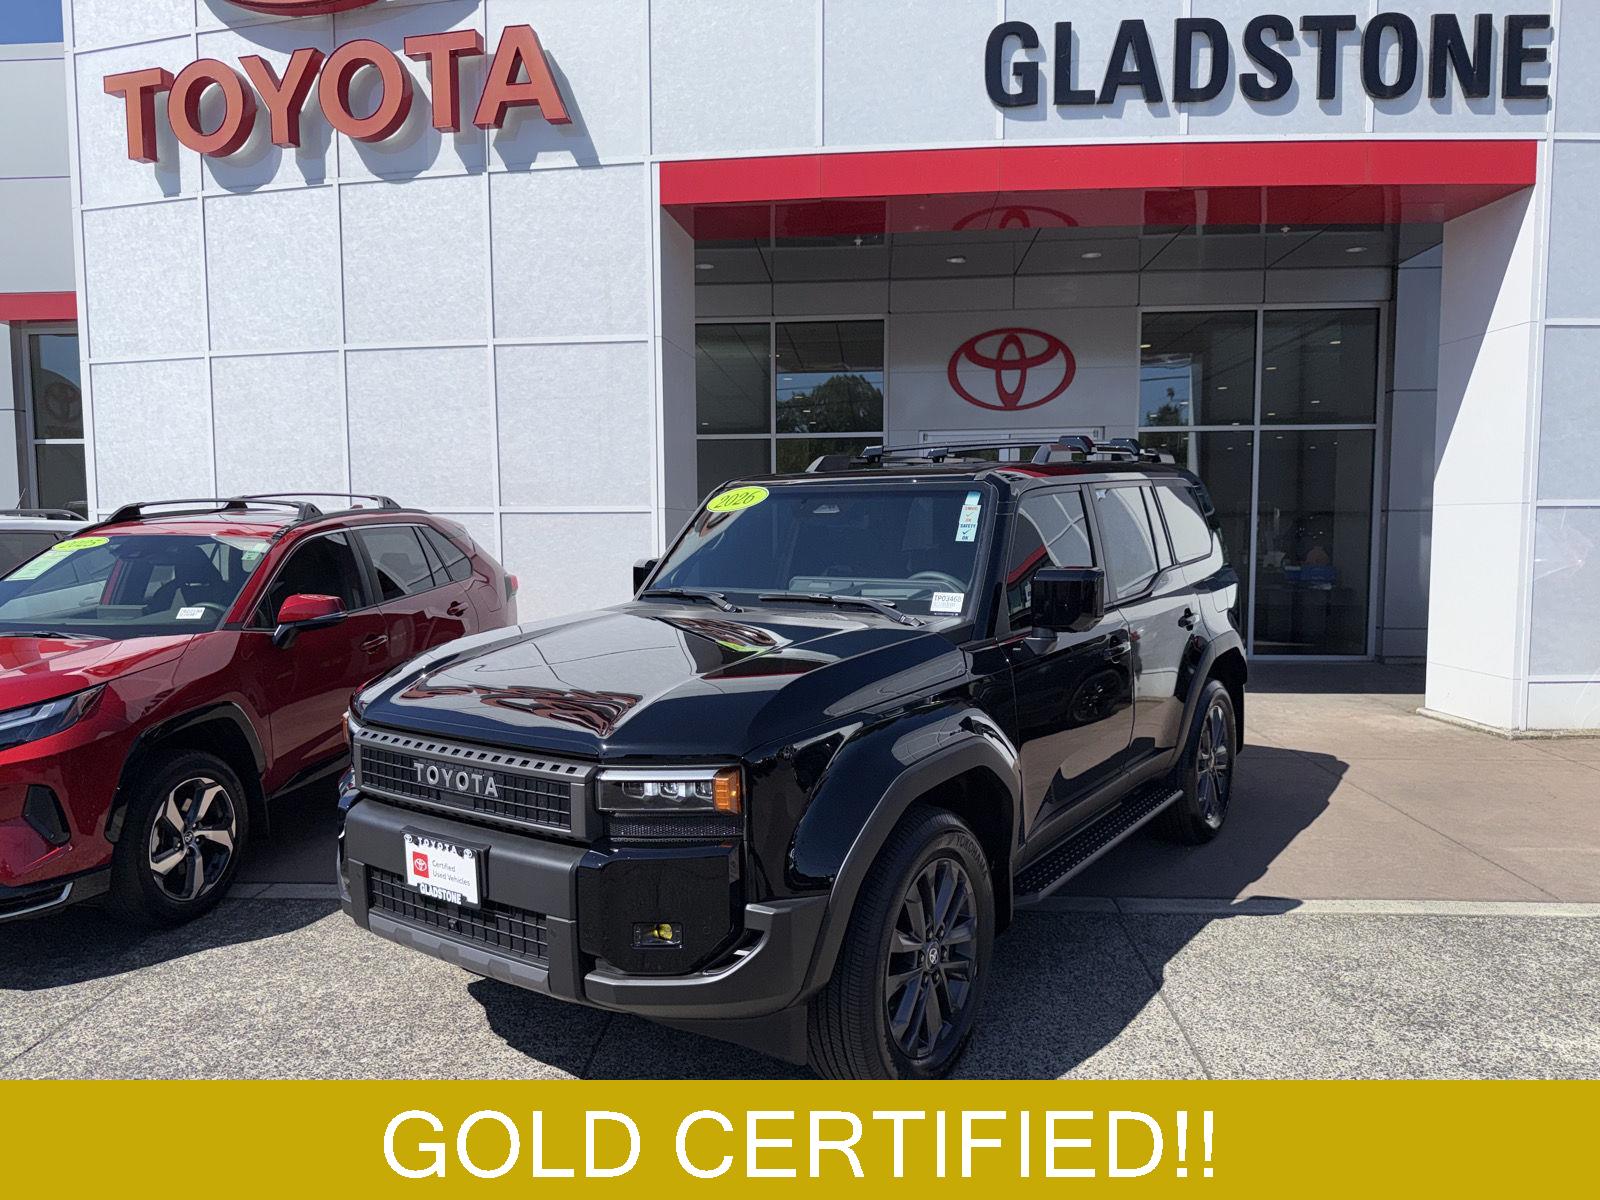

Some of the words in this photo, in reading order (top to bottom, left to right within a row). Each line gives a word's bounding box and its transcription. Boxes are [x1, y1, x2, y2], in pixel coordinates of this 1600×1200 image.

[985, 12, 1551, 108] GLADSTONE
[103, 23, 572, 164] TOYOTA
[714, 490, 761, 509] 2026
[413, 762, 498, 798] TOYOTA
[417, 836, 458, 855] TOYOTA
[432, 860, 456, 872] Certified
[432, 870, 447, 880] Used
[447, 873, 471, 887] Vehicles
[419, 883, 463, 905] GLADSTONE
